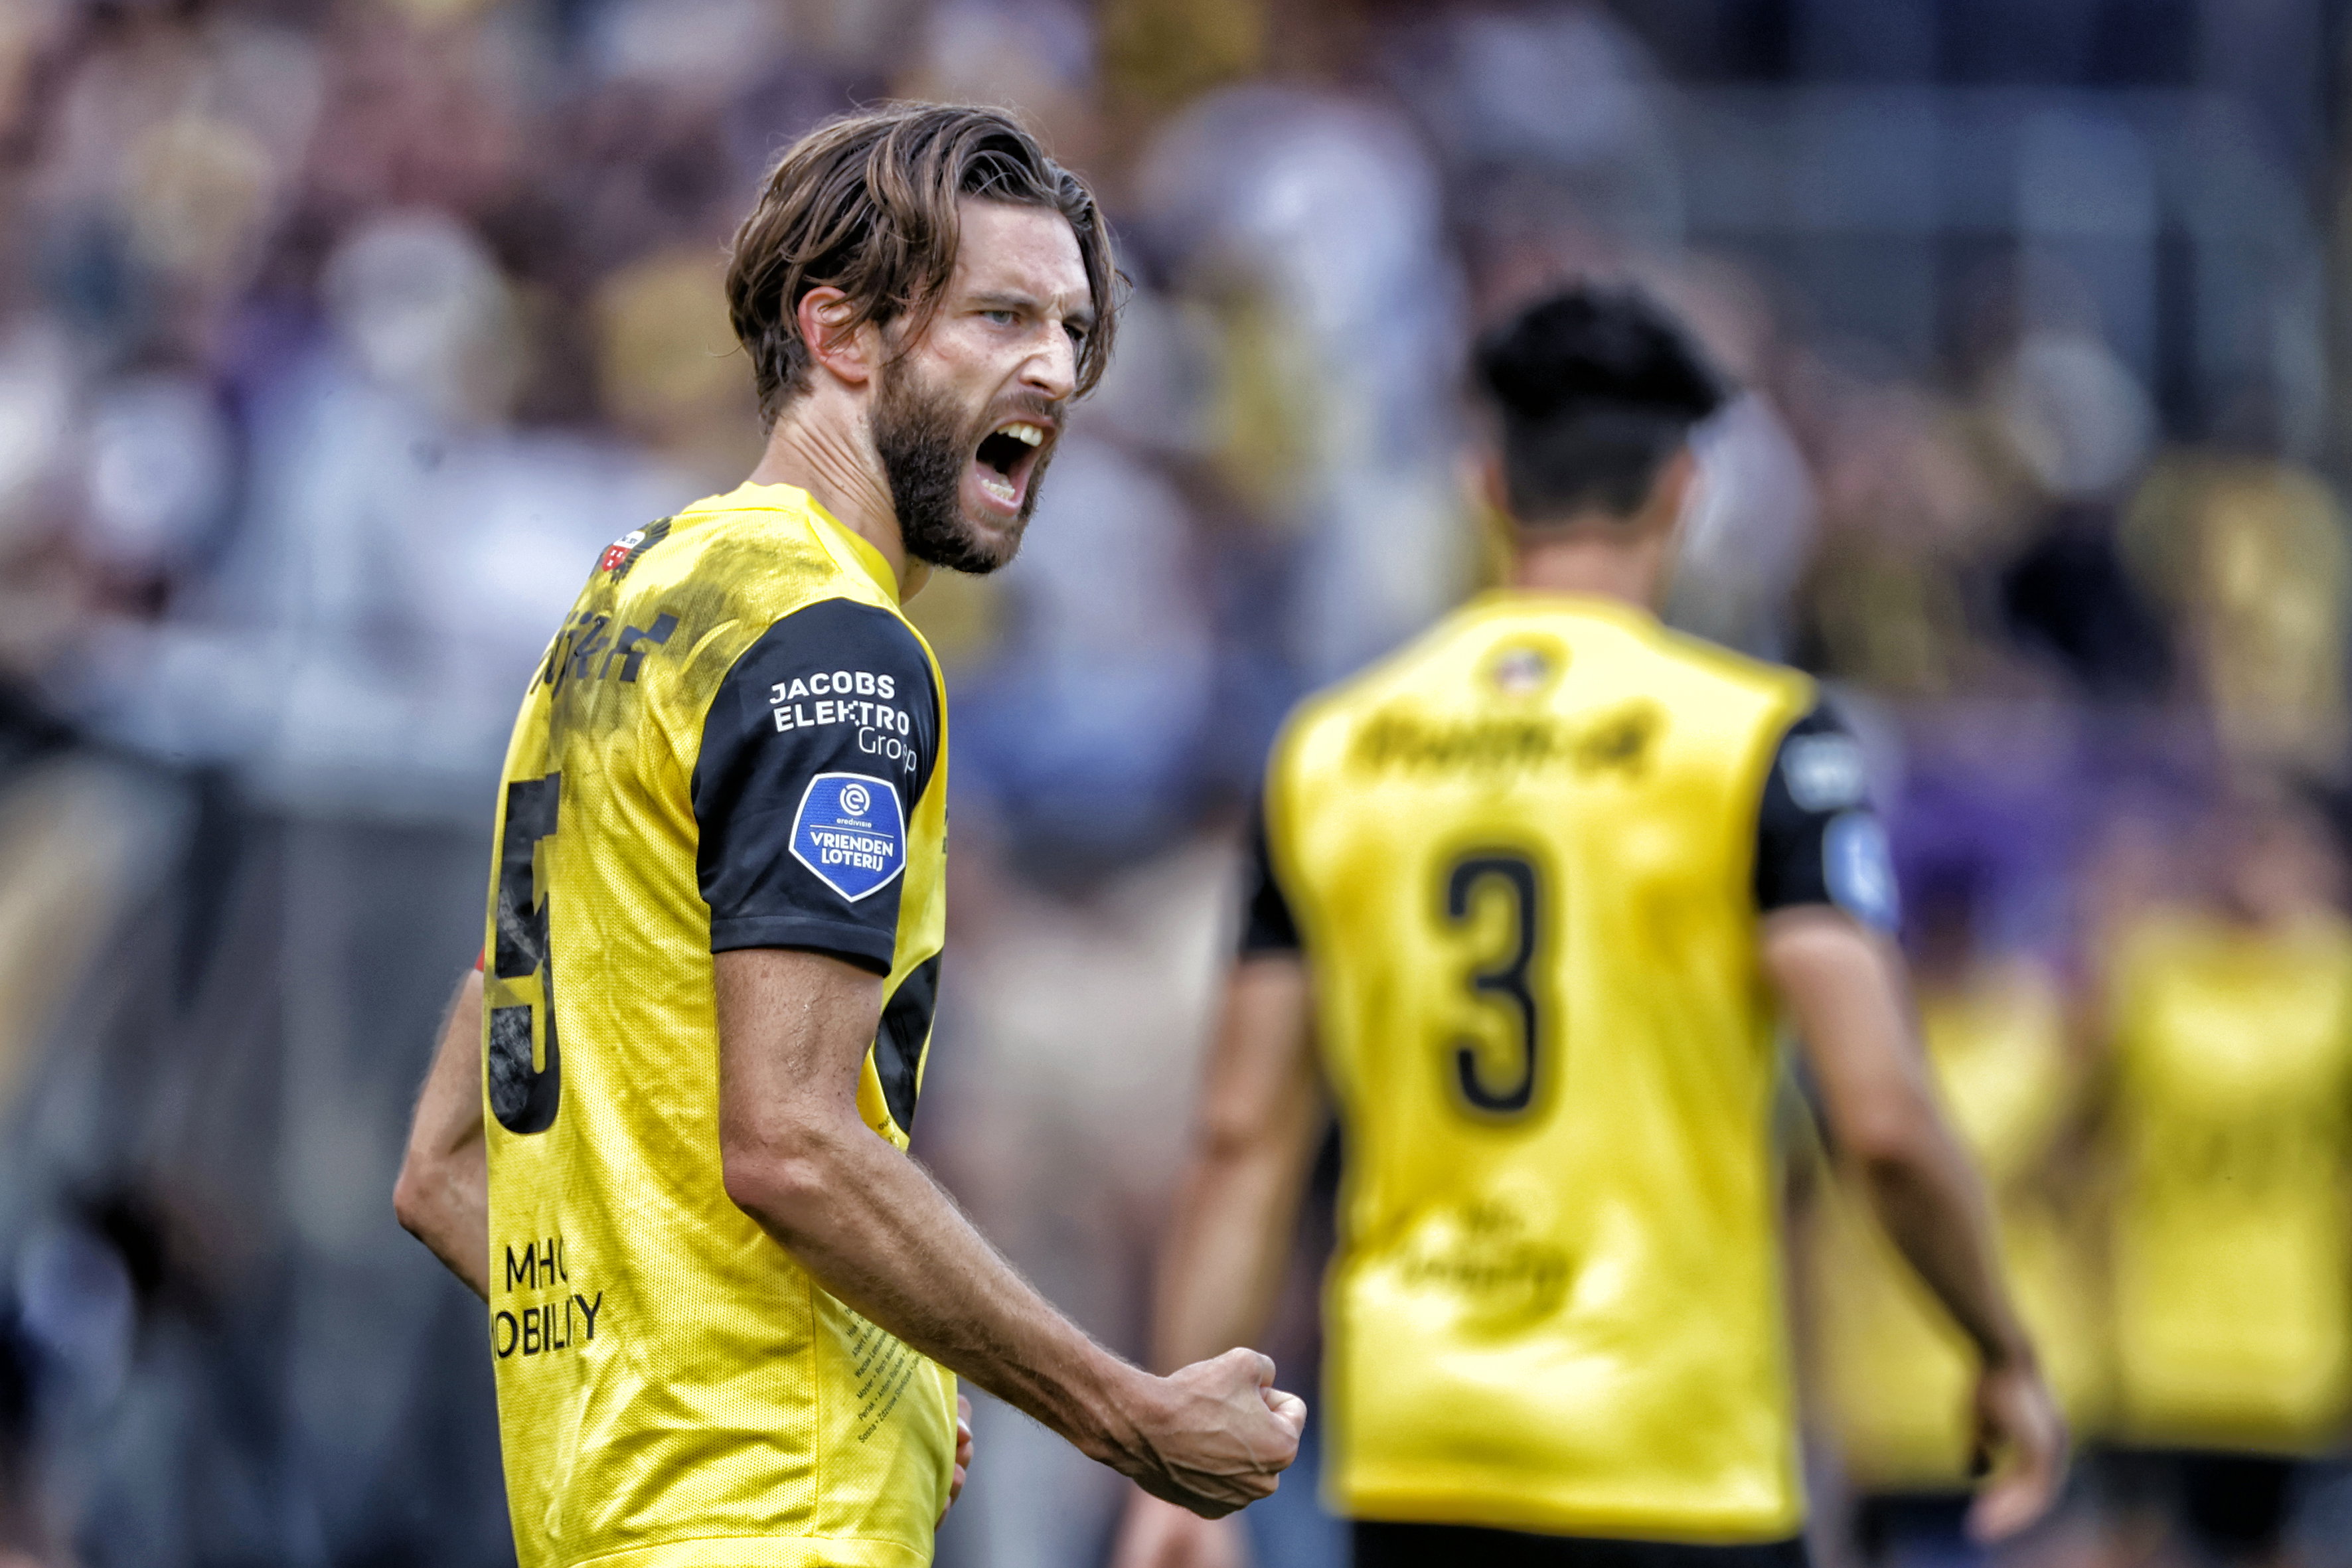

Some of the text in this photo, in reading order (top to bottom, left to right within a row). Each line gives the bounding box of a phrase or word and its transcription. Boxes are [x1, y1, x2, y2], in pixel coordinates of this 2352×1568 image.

[769, 670, 895, 704] JACOBS
[773, 700, 909, 736] ELEKTRO
[859, 726, 917, 774] Groep
[836, 817, 872, 828] eredivisie
[810, 831, 894, 857] VRIENDEN
[821, 848, 884, 872] LOTERIJ
[488, 771, 562, 1135] 5
[1446, 852, 1537, 1113] 3
[858, 1423, 877, 1444] Sosna
